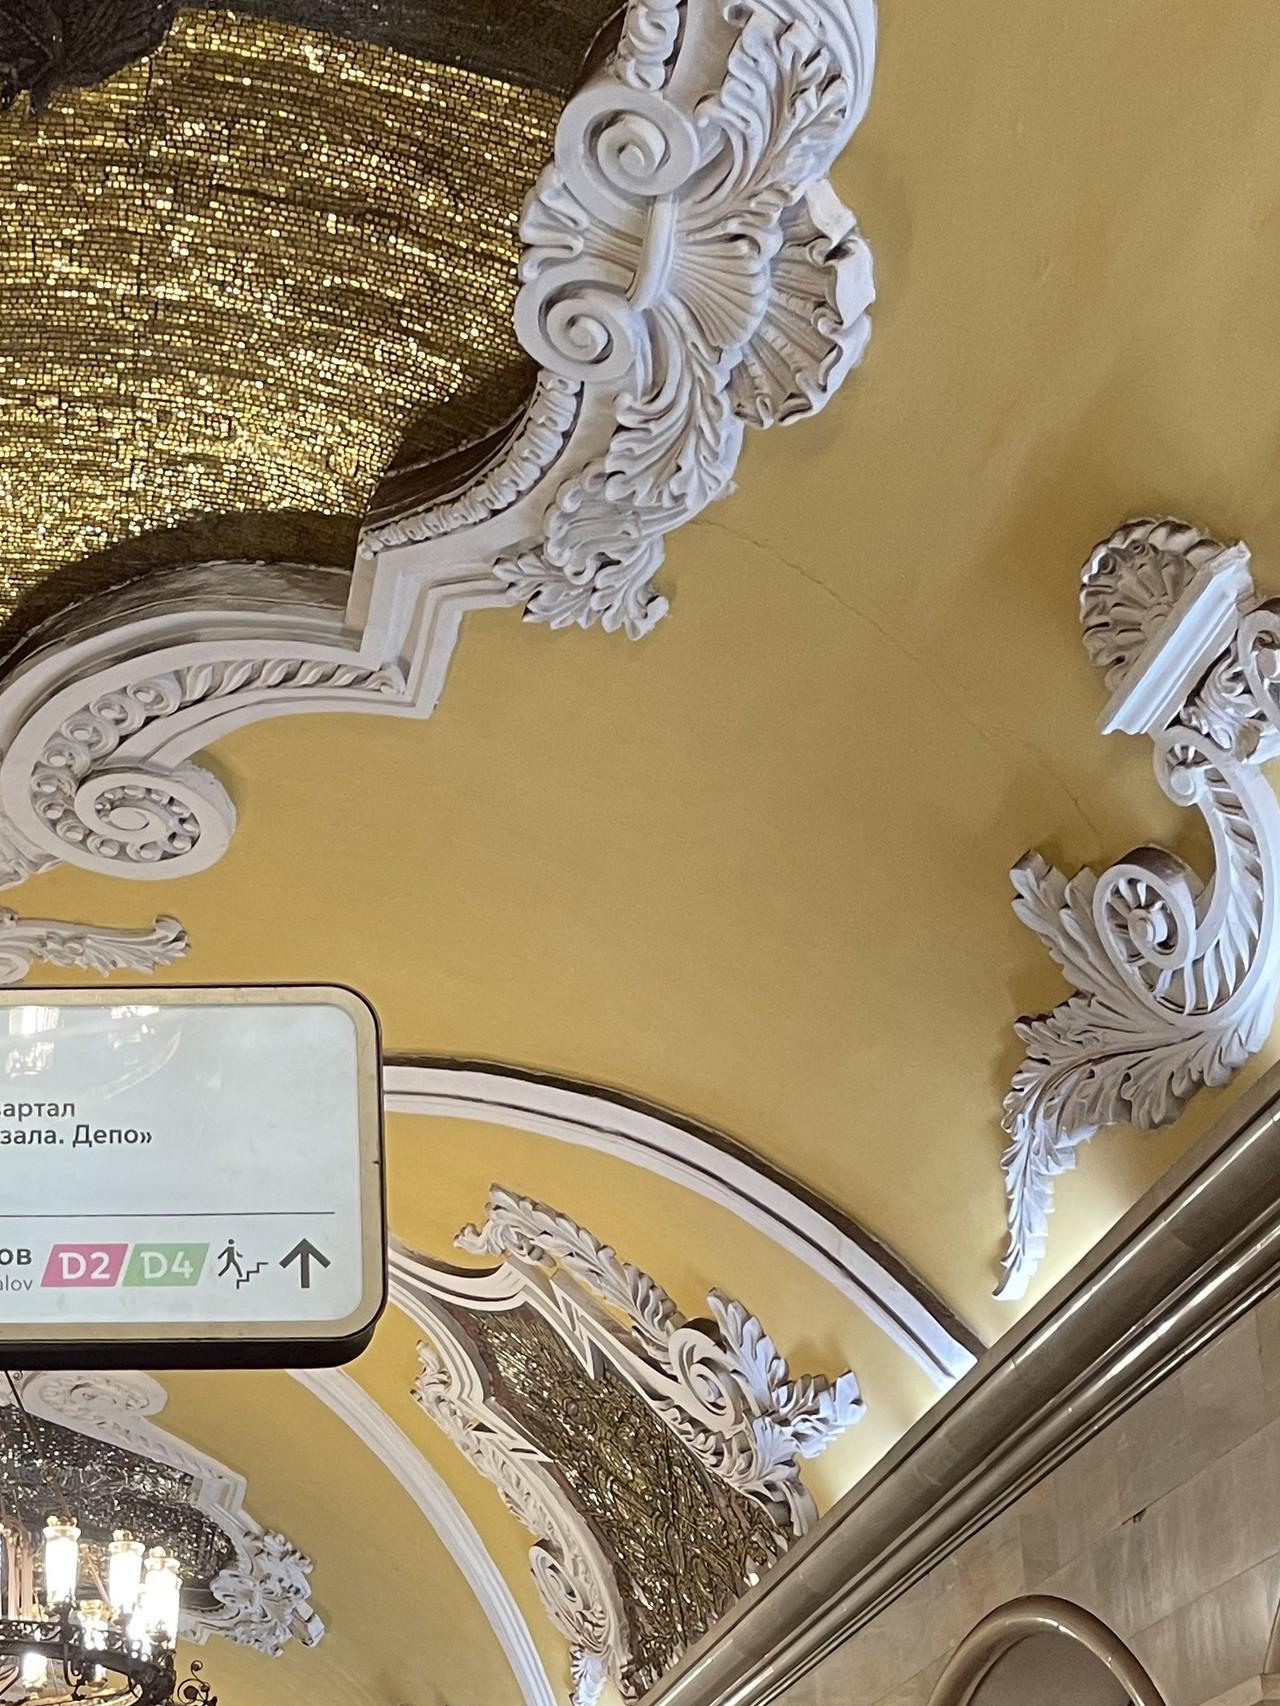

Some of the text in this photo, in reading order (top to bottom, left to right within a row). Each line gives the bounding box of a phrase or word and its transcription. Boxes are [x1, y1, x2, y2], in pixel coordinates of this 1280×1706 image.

[71, 1126, 153, 1149] Депо»
[58, 1251, 194, 1280] D2 D4
